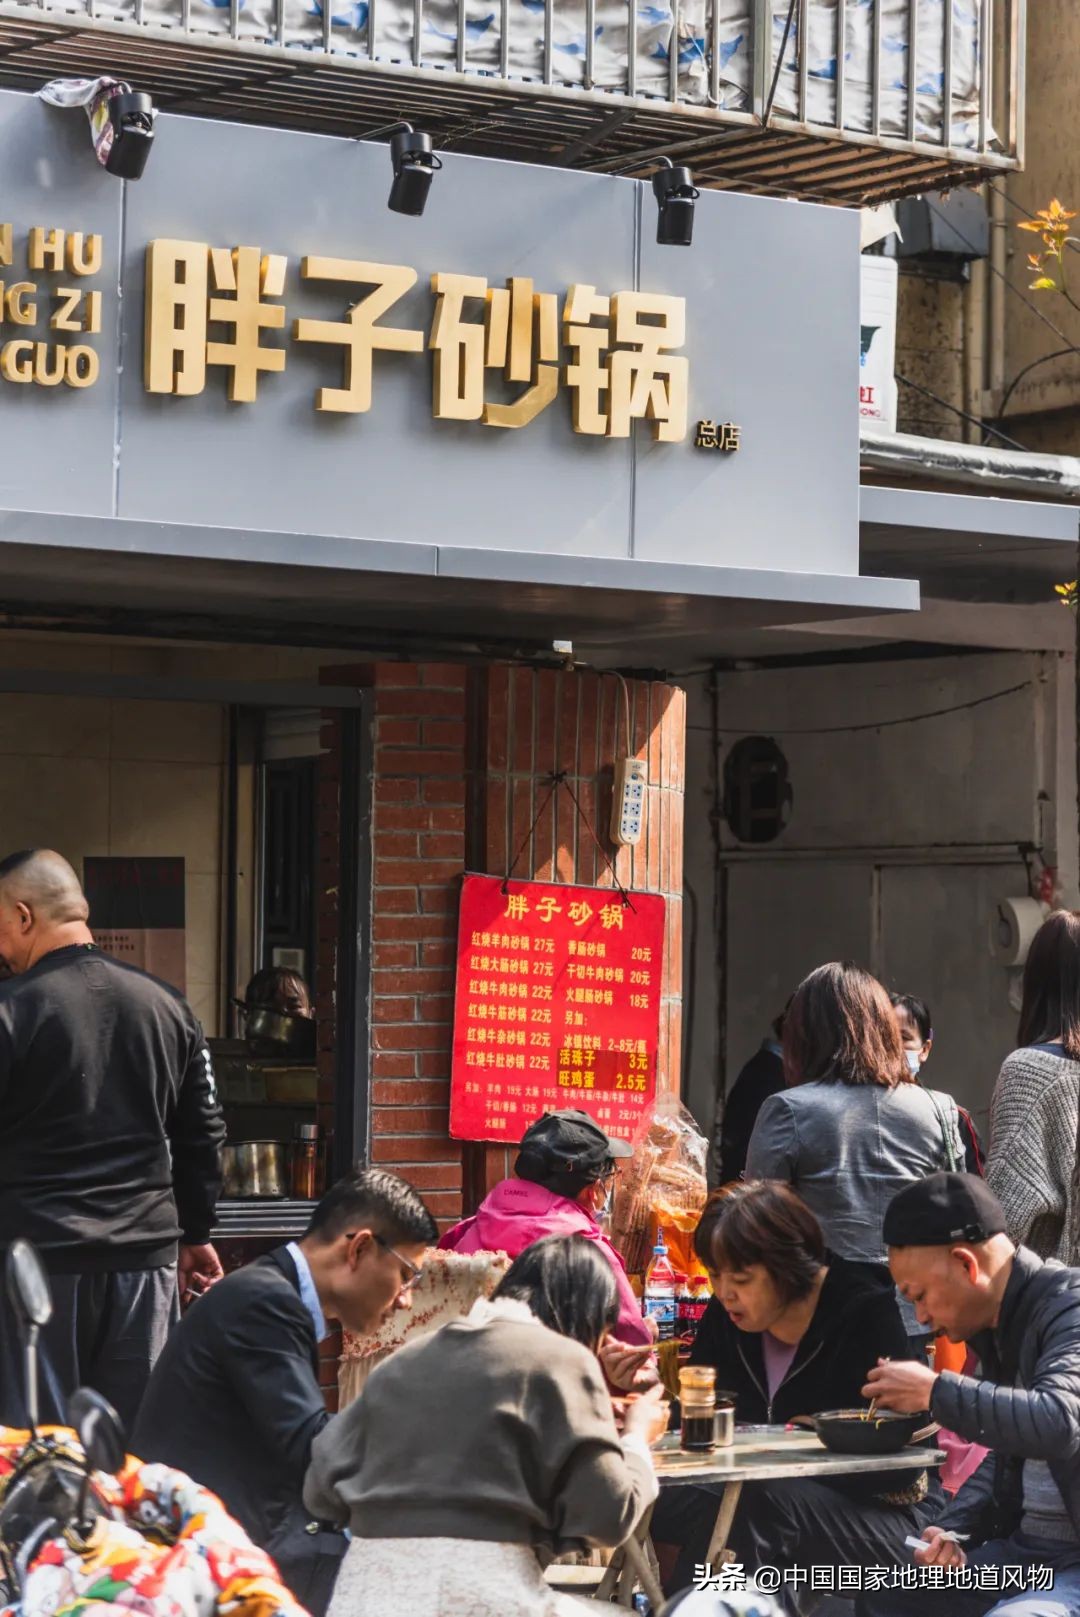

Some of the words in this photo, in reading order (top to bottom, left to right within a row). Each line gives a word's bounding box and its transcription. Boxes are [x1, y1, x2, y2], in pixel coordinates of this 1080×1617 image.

[28, 226, 102, 275] HU
[0, 281, 37, 326] G
[51, 287, 102, 333] ZI
[144, 238, 690, 443] 胖子砂锅
[1, 339, 100, 388] GUO
[696, 420, 742, 451] 总店
[504, 894, 624, 930] 胖子砂锅
[534, 938, 555, 953] 27元
[632, 947, 652, 962] 20元
[533, 962, 554, 976] 27元
[630, 971, 650, 986] 20元
[469, 979, 527, 998] 红烧牛肉砂锅
[532, 986, 552, 1000] 22元
[630, 994, 649, 1008] 18元
[531, 1009, 552, 1024] 22元
[530, 1032, 551, 1047] 22元
[530, 1056, 550, 1070] 22元
[560, 1050, 596, 1066] 活珠子
[629, 1054, 648, 1070] 3元
[558, 1070, 595, 1088] 旺鸡蛋
[616, 1073, 646, 1091] 2.5元
